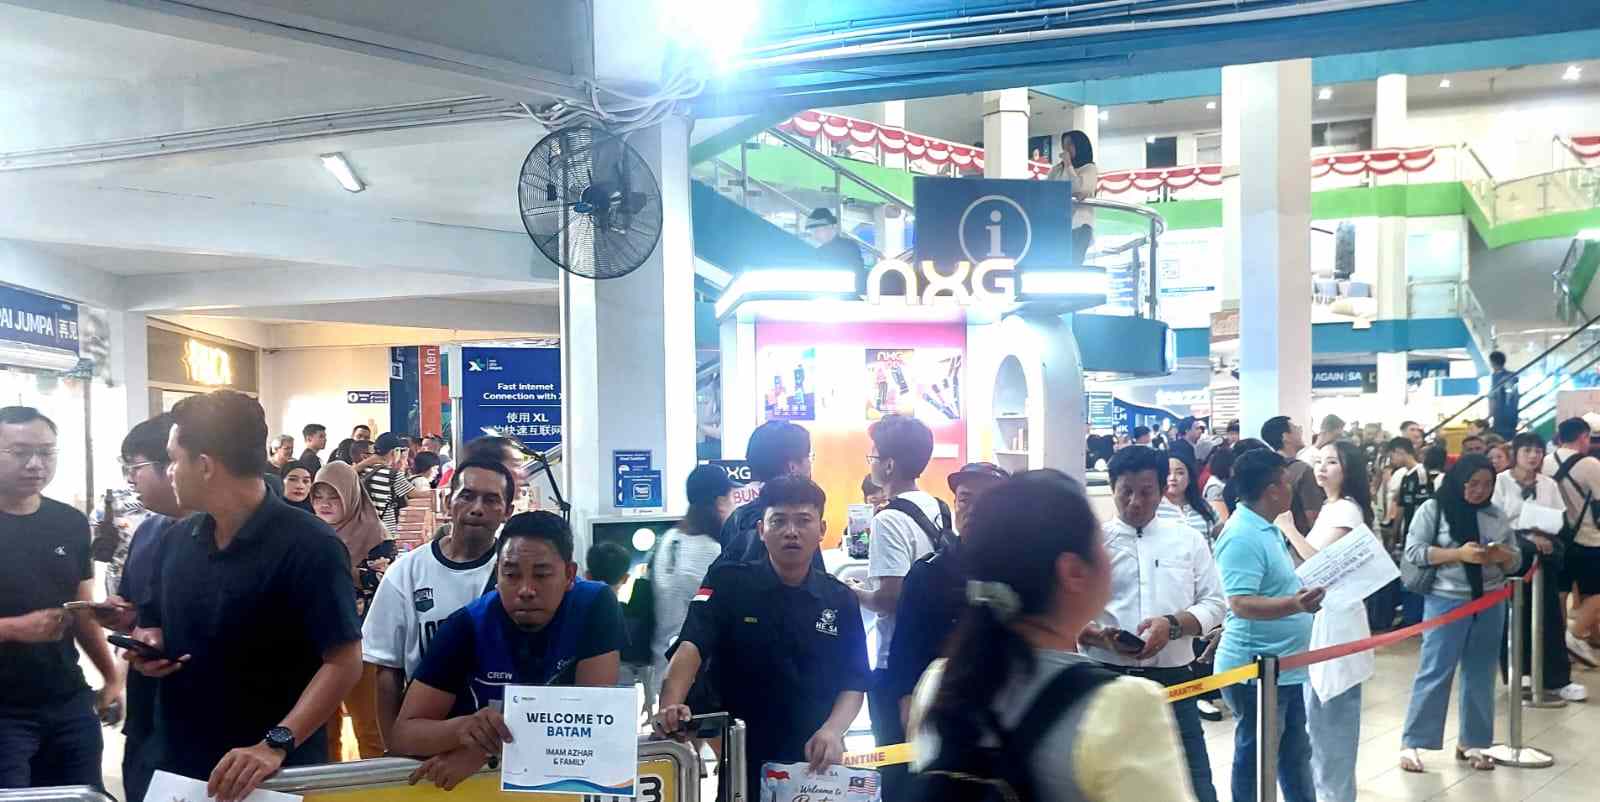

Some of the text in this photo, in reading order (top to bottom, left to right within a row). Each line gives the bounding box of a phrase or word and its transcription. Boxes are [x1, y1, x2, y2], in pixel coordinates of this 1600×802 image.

[15, 311, 55, 337] JUMPA
[1314, 372, 1344, 382] AGAIN
[497, 382, 554, 390] Fast Internet
[483, 392, 535, 400] Connection
[537, 392, 557, 400] with
[507, 412, 549, 423] 使用 XL
[487, 671, 513, 680] CREW
[526, 712, 614, 725] WELCOME TO
[547, 726, 592, 738] BATAM
[545, 748, 593, 757] IMAM AZHAR
[559, 758, 586, 766] FAMILY
[800, 784, 834, 794] Welcome
